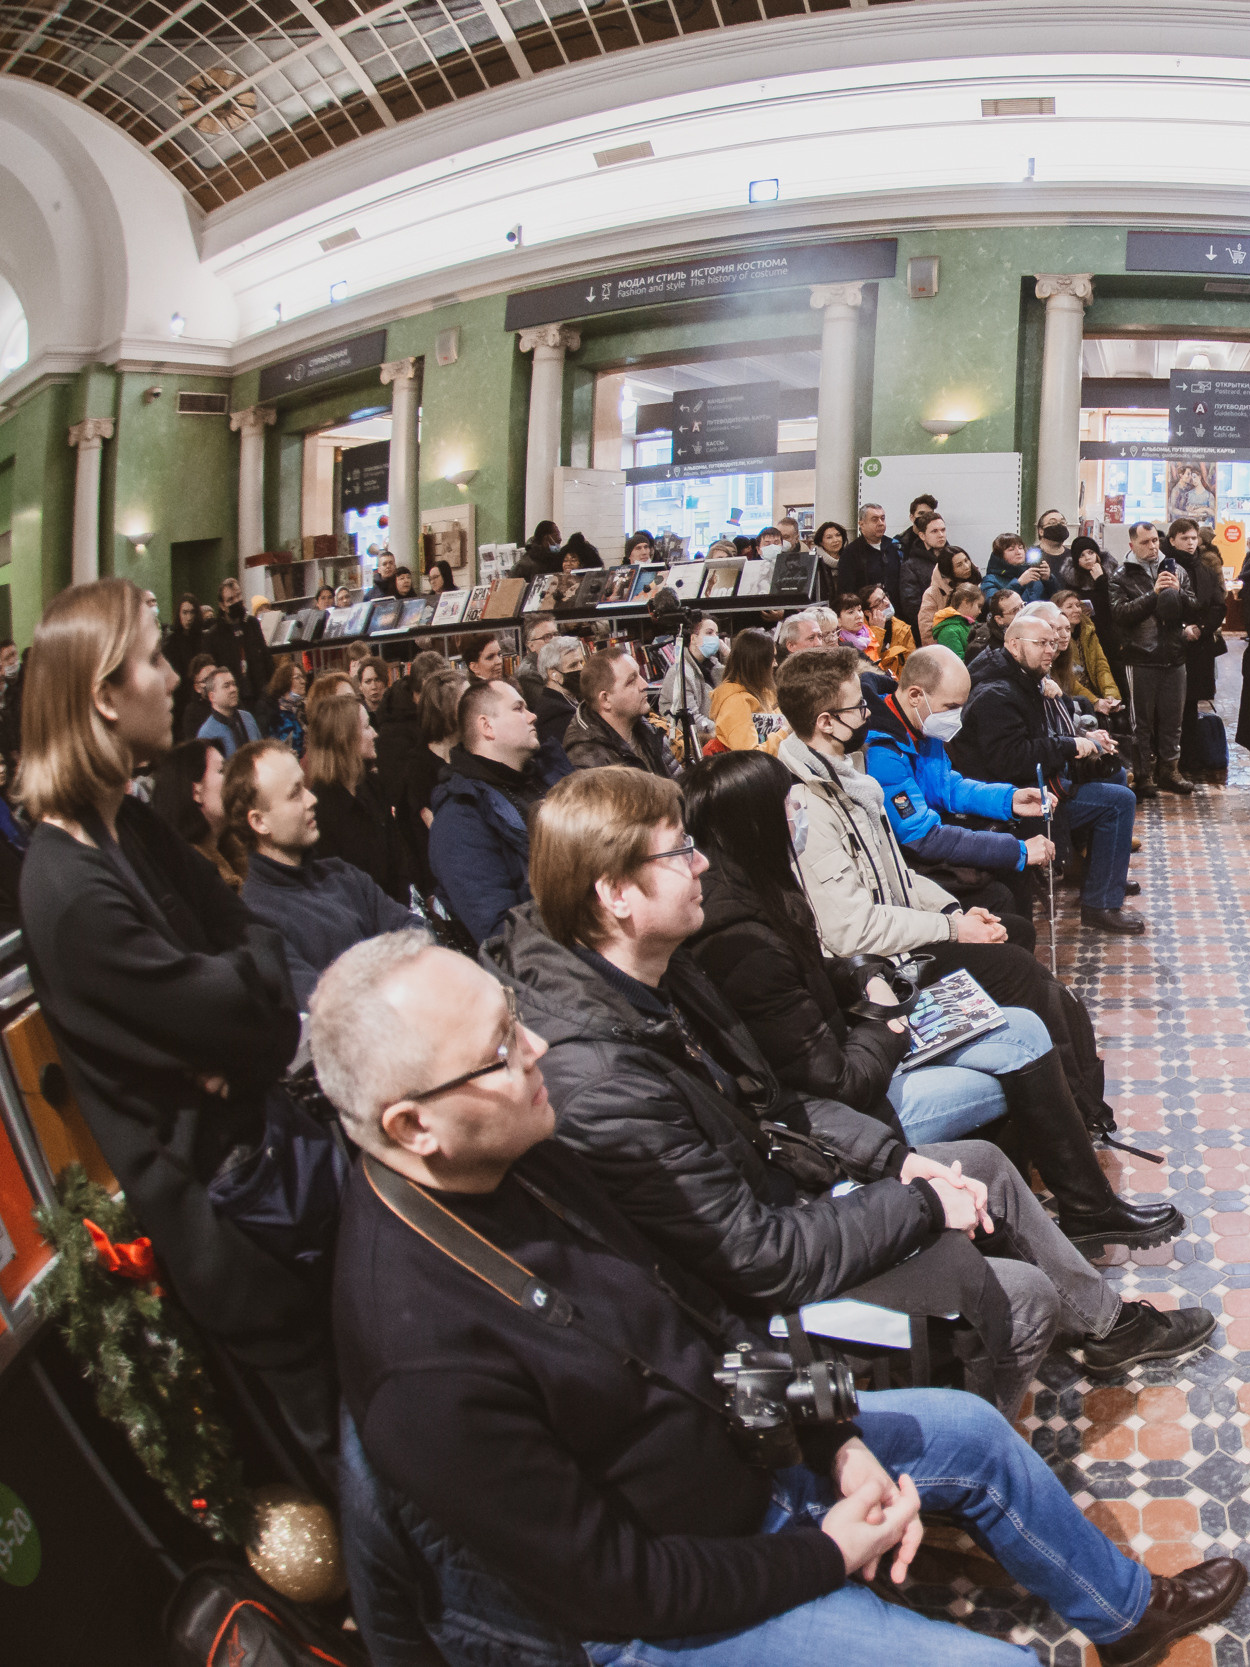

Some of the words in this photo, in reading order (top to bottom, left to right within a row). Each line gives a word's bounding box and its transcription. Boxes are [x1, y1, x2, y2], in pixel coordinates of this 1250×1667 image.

[617, 285, 647, 299] Fashion
[648, 282, 664, 294] and
[666, 280, 686, 292] style
[690, 277, 706, 287] The
[707, 272, 737, 286] history
[738, 271, 749, 281] of
[750, 267, 789, 279] costume
[618, 278, 646, 290] МОДА
[647, 275, 655, 285] И
[655, 271, 687, 284] СТИЛЬ
[691, 263, 735, 278] ИСТОРИЯ
[736, 257, 788, 272] КОСТЮМА
[1215, 381, 1250, 390] ОТКРЫТКИ,
[1213, 425, 1236, 433] КАССЫ
